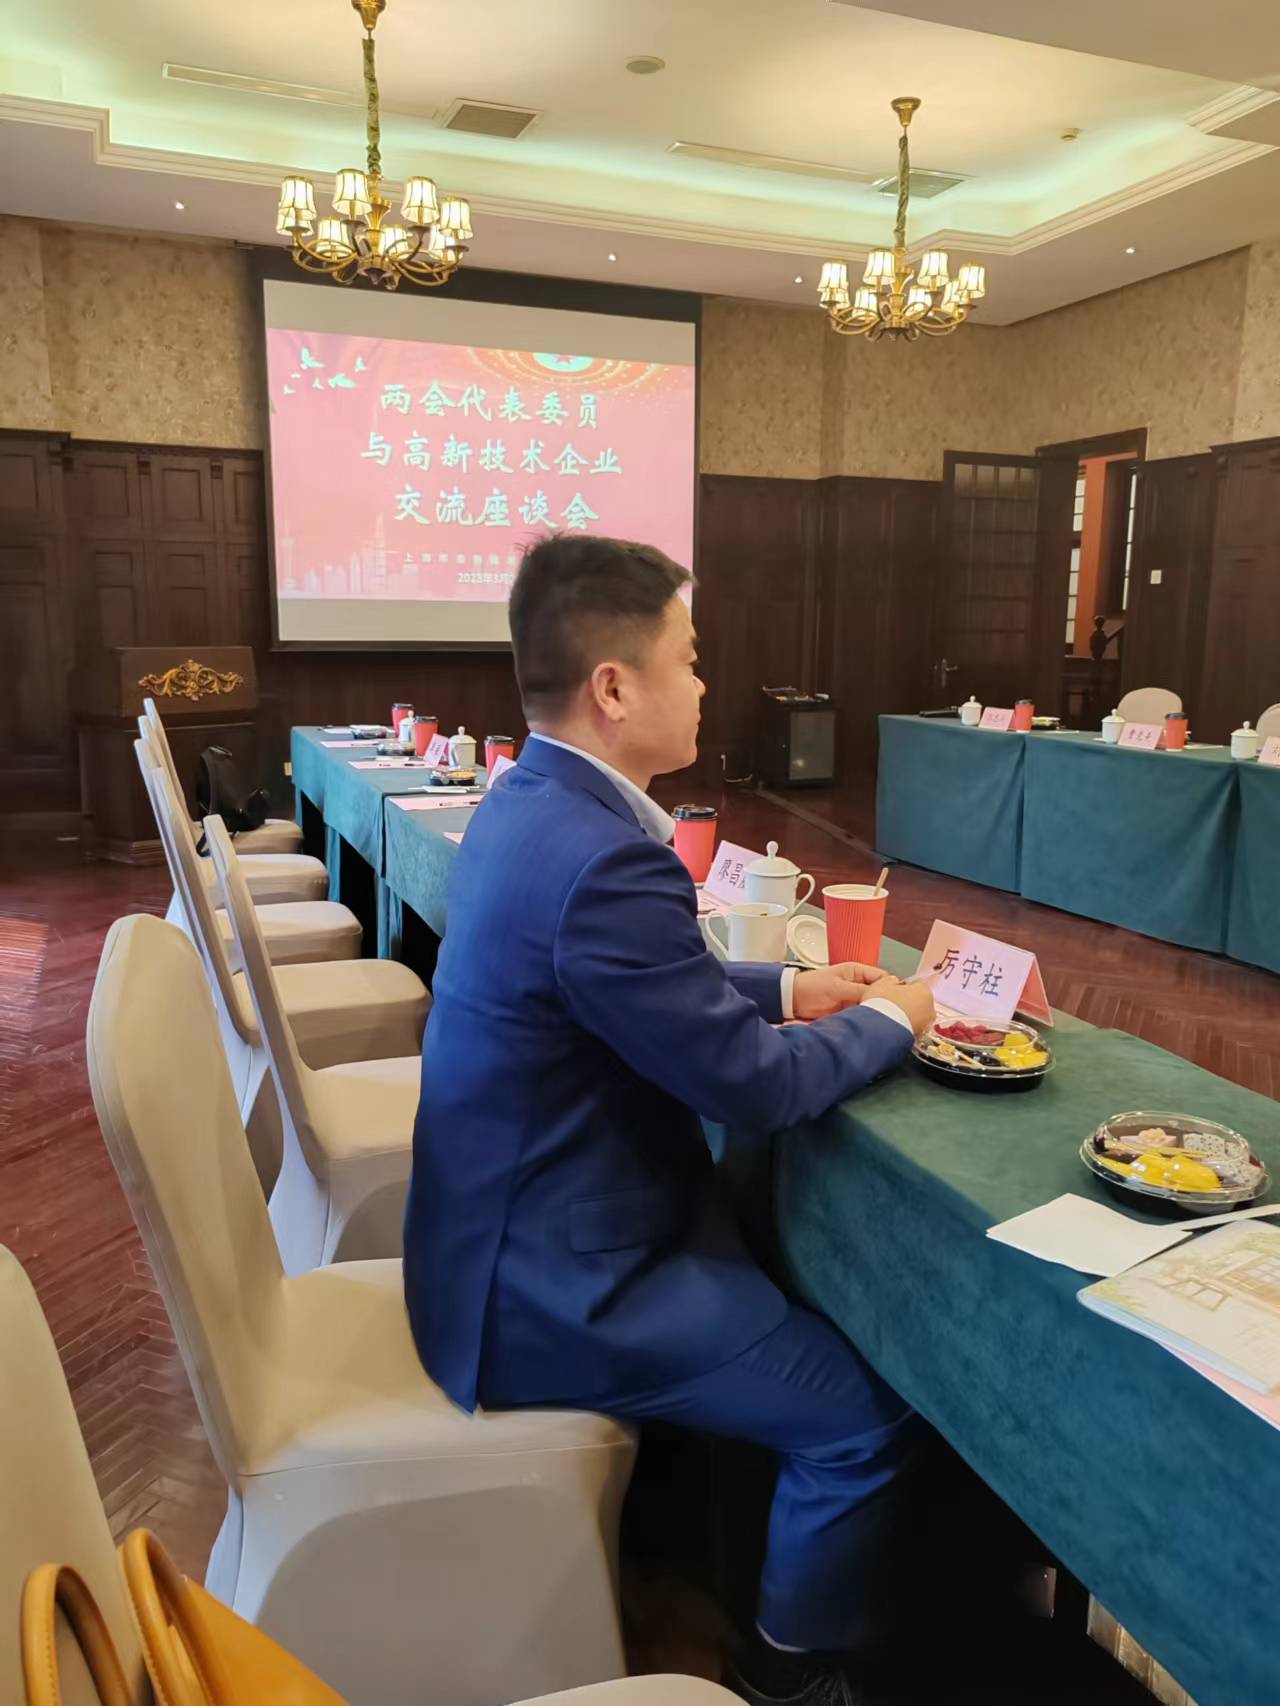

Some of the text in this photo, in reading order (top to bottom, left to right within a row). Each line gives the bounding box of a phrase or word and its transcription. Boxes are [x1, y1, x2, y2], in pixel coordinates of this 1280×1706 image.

[381, 383, 599, 429] 两会代表委员
[360, 430, 623, 475] 与高新技术企业
[394, 484, 599, 529] 交流座谈会
[933, 949, 1003, 996] 厉守柱
